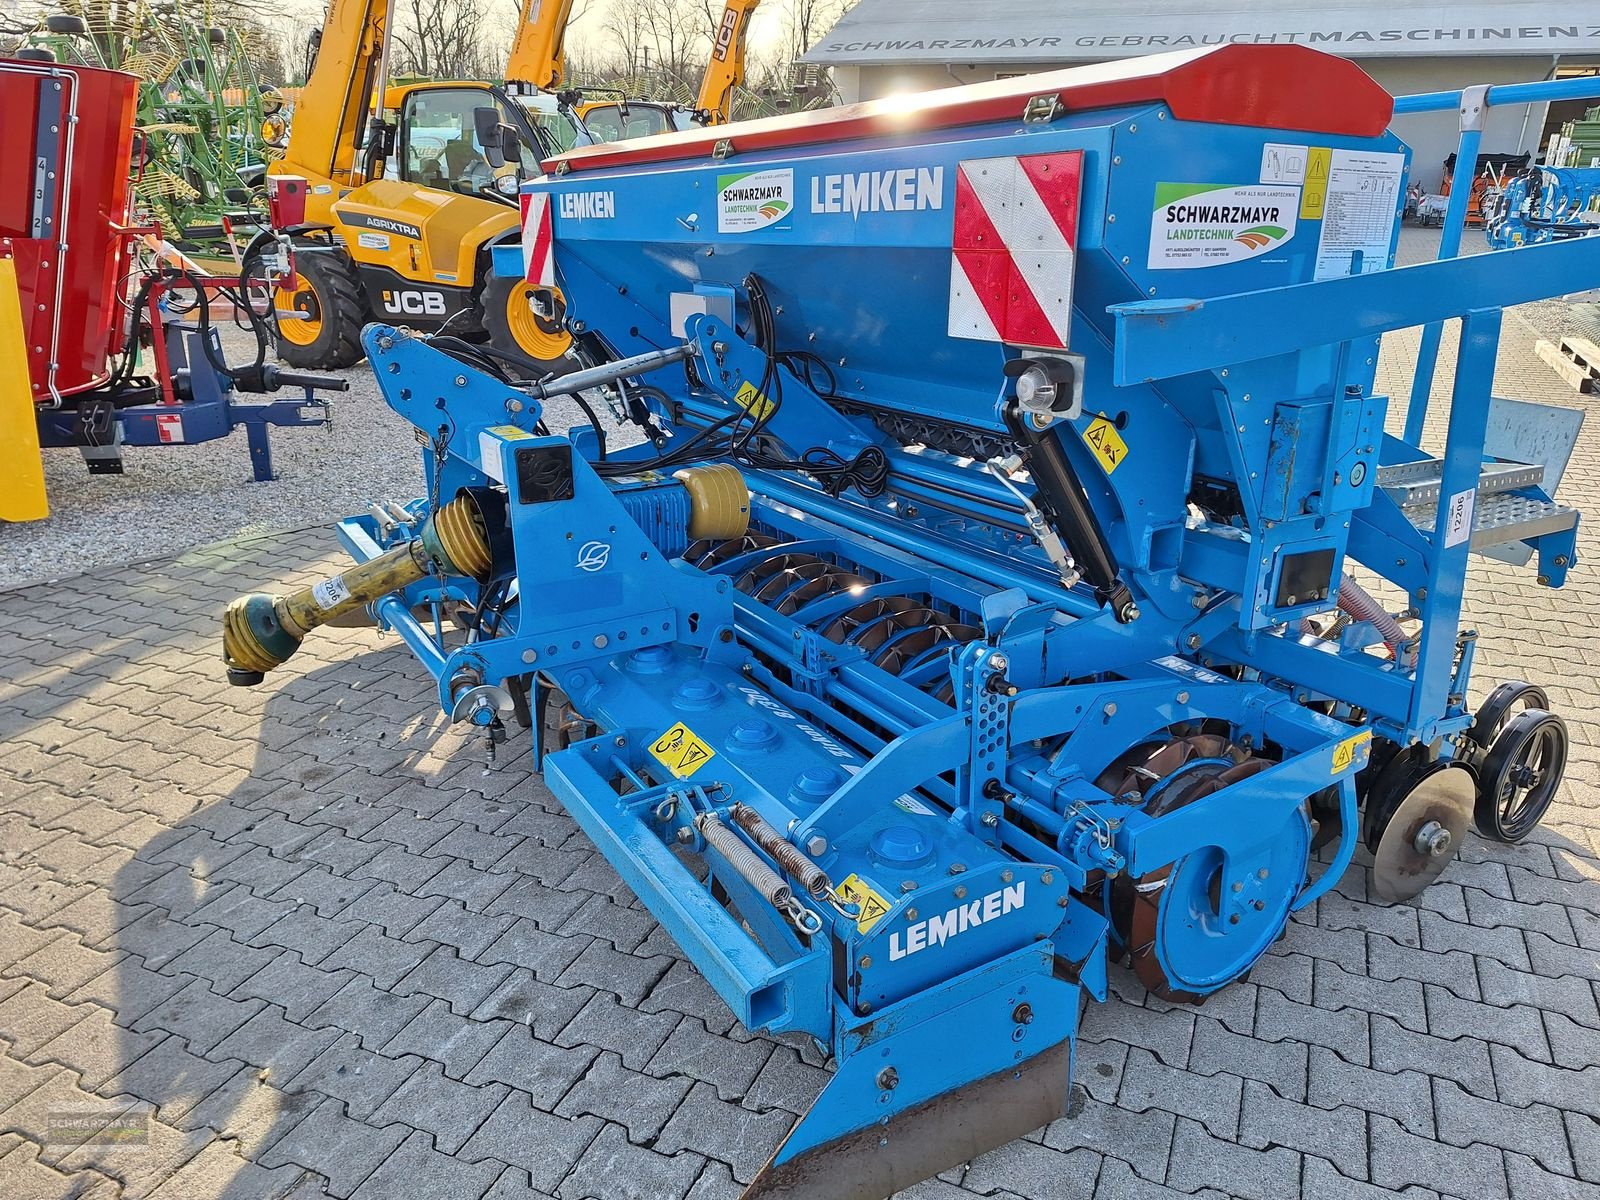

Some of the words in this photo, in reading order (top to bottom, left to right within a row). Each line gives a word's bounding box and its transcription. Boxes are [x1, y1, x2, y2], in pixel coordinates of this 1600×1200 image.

[713, 9, 738, 61] JCB
[825, 37, 1062, 52] SCHWARZMAYR
[38, 160, 45, 171] 4
[36, 189, 43, 199] 3
[723, 185, 783, 202] SCHWARZMAYR
[811, 166, 944, 223] LEMKEN
[560, 191, 615, 224] LEMKEN
[724, 204, 758, 214] LANDTECHNIK
[1166, 205, 1280, 224] SCHWARZMAYR
[34, 217, 41, 228] 2
[366, 217, 420, 237] AGRIXTRA
[1166, 228, 1235, 240] LANDTECHNIK
[382, 290, 447, 315] JCB
[1454, 496, 1465, 533] 12206
[738, 687, 796, 720] 8/300
[795, 724, 855, 759] Zirkon
[889, 880, 1026, 962] LEMKEN
